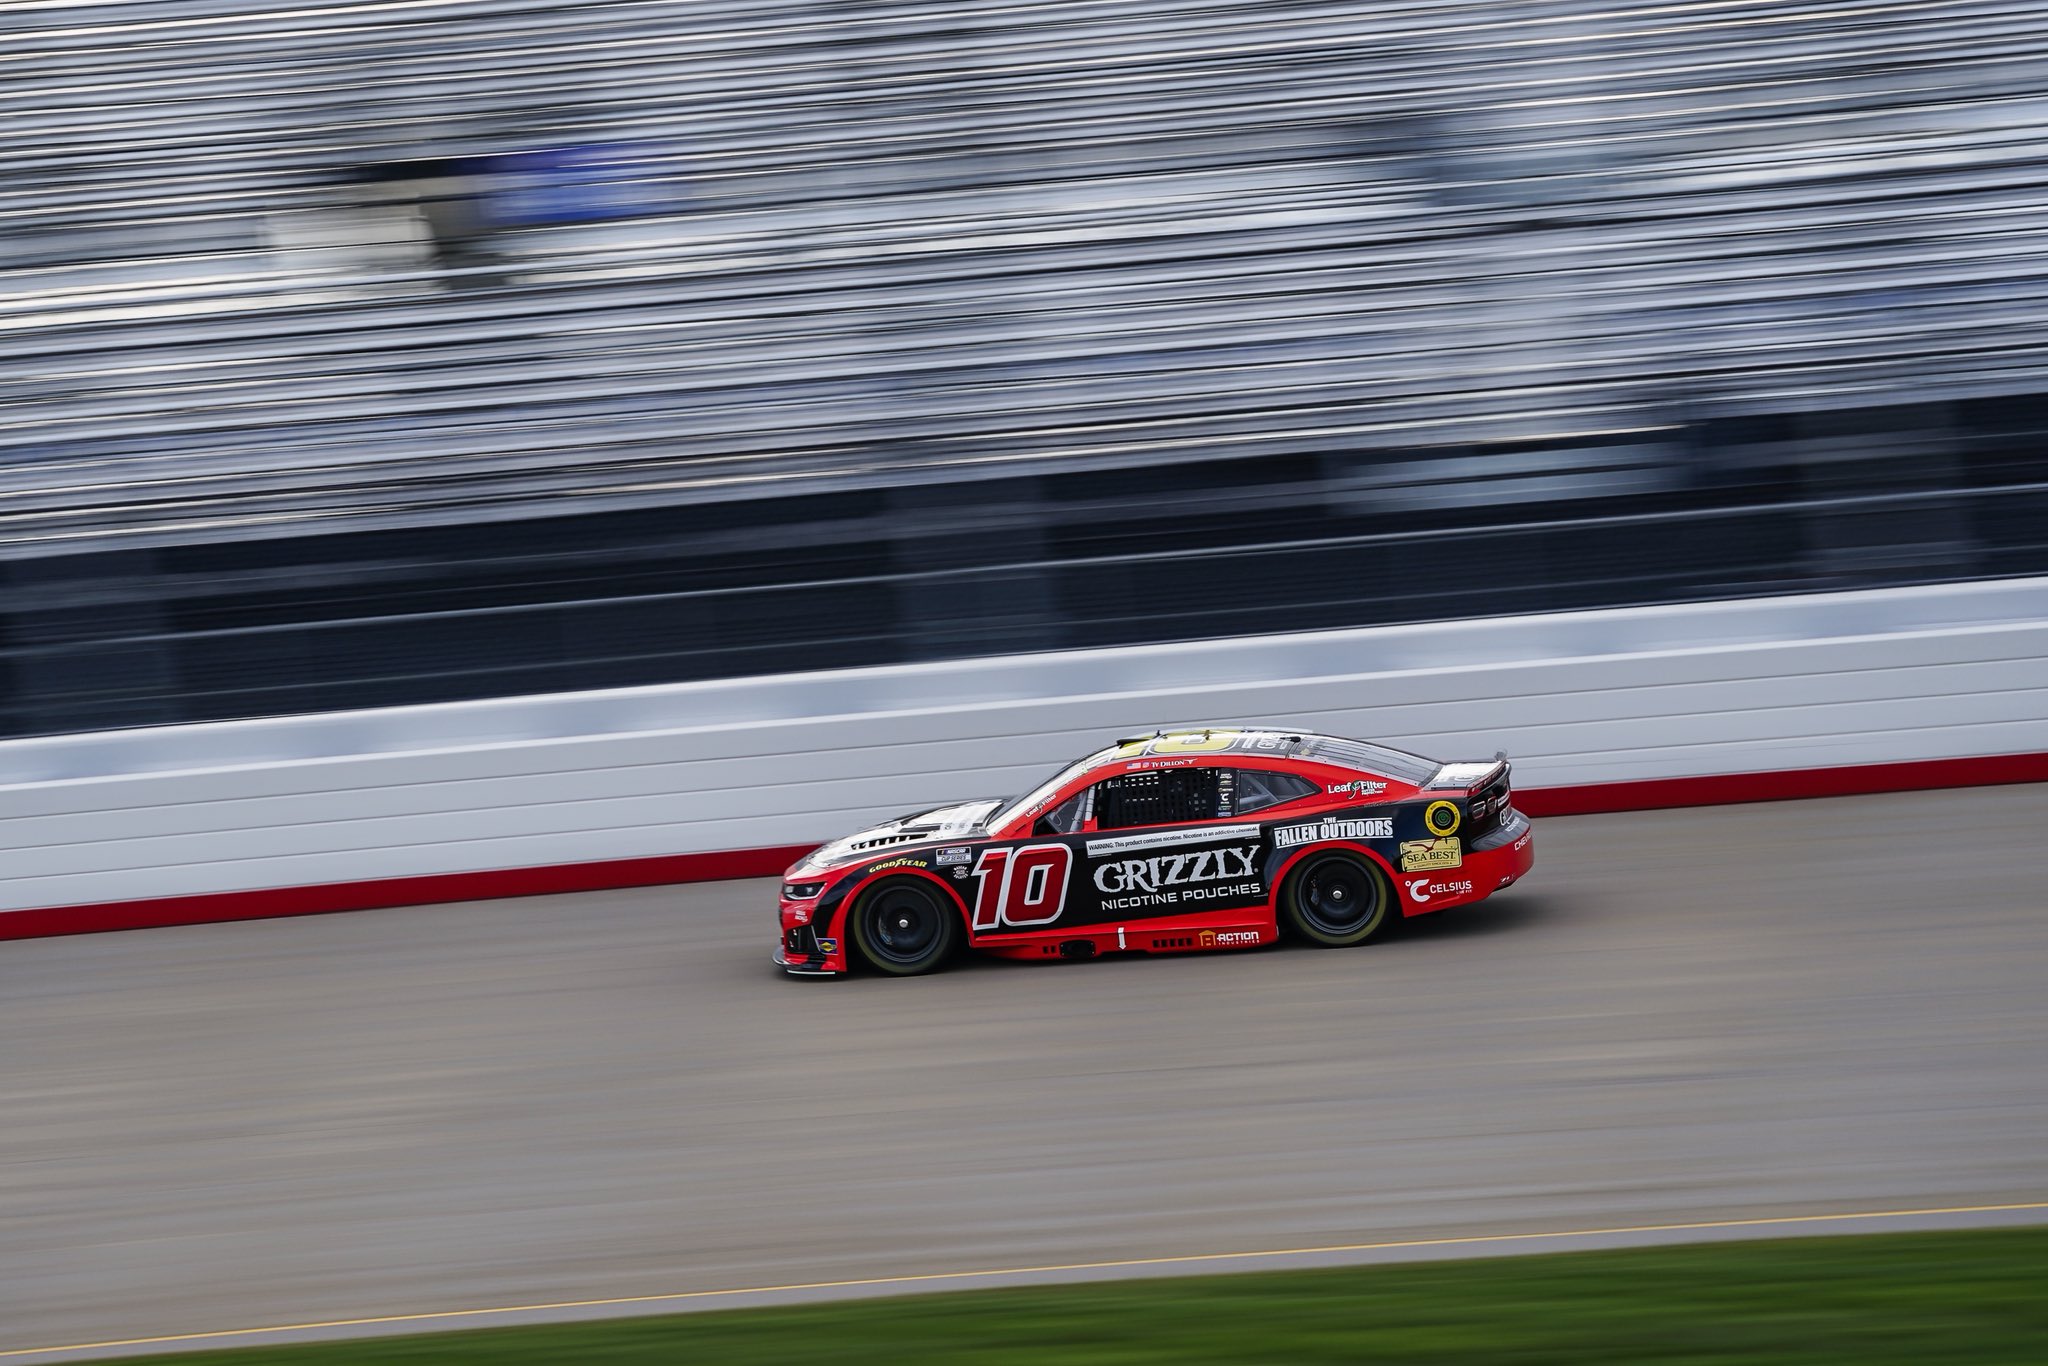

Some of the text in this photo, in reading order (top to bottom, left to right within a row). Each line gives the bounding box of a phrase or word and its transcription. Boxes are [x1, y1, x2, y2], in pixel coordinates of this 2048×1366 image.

[1274, 820, 1393, 847] FALLEN OUTDOORS
[1088, 842, 1114, 850] WARNING:
[1125, 839, 1143, 847] product
[868, 857, 928, 873] GOODYEAR
[1406, 850, 1456, 864] SEA BEST
[1093, 845, 1260, 893] GRIZZLY
[970, 843, 1073, 931] 10
[1430, 880, 1472, 893] CELSIUS
[1101, 883, 1261, 910] NICOTINE POUCHES
[1217, 931, 1259, 942] ACTION
